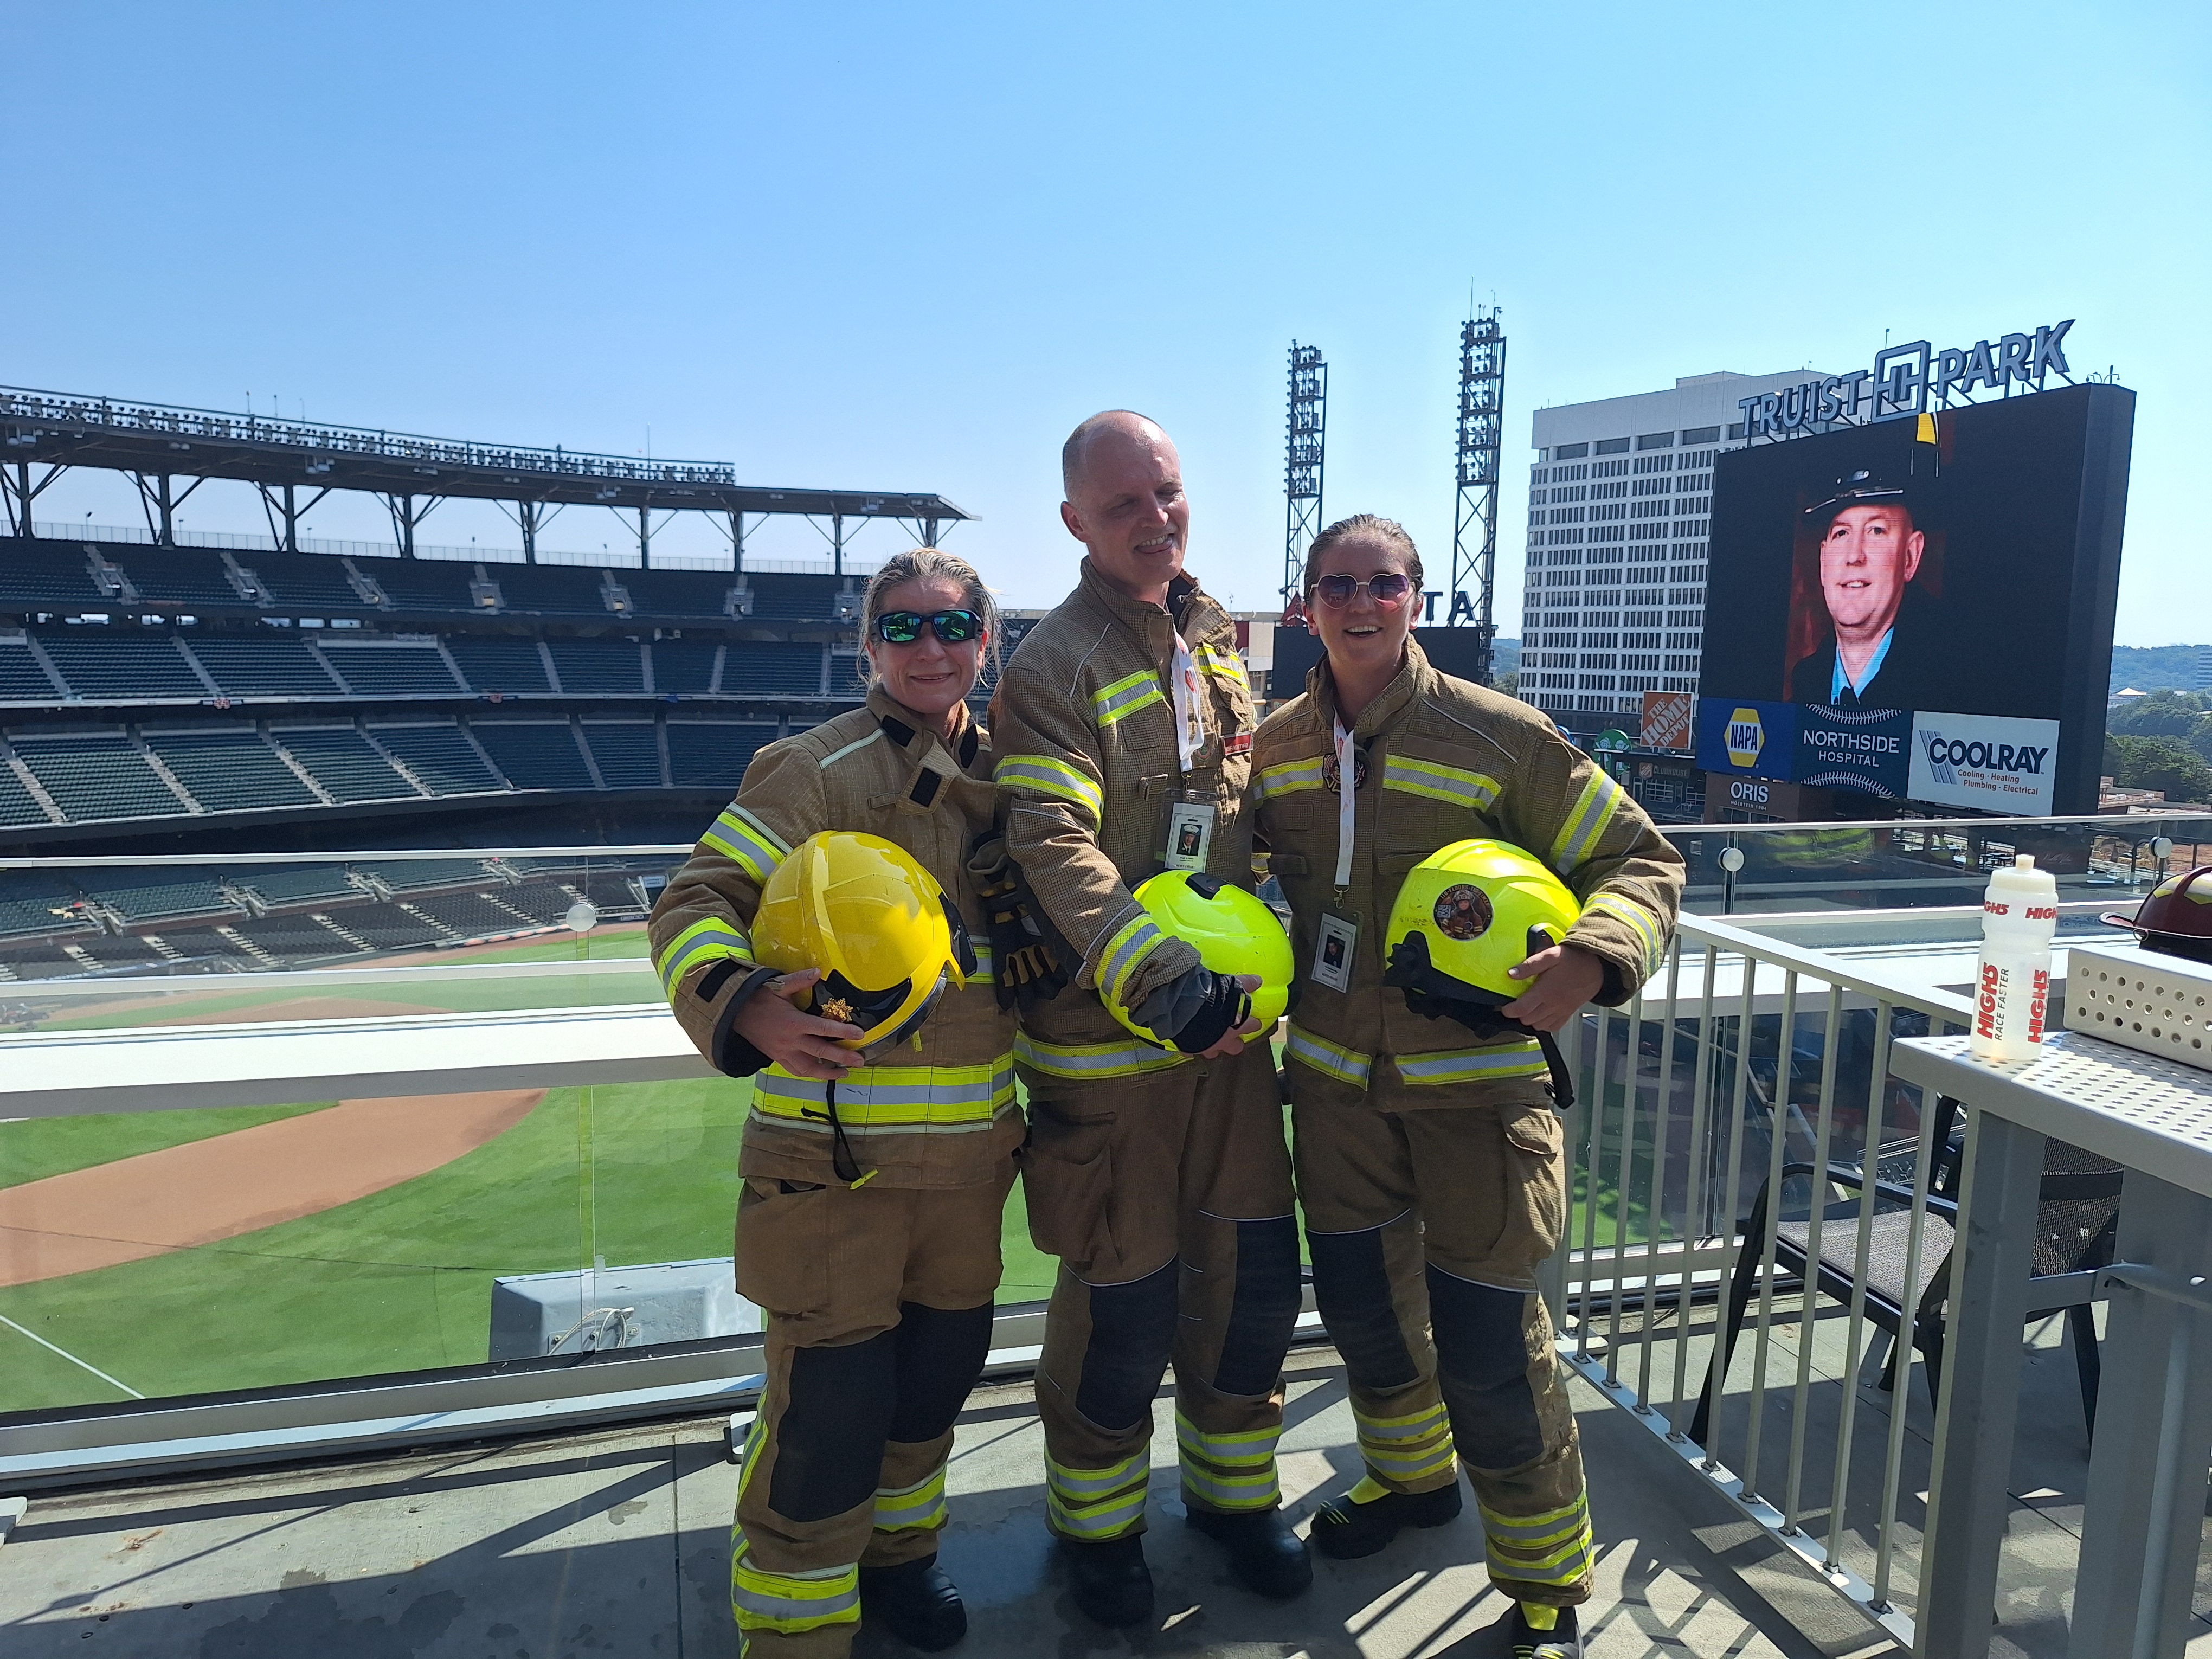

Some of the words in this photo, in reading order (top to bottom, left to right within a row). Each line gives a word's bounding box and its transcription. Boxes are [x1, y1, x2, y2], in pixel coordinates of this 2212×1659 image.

[1738, 370, 1868, 436] TRUIST
[1937, 319, 2076, 398] PARK
[1642, 694, 1691, 747] HOME
[1647, 698, 1668, 719] THE
[1659, 713, 1690, 747] DEPOT
[1730, 724, 1758, 751] NAPA
[1803, 730, 1900, 754] NORTHSIDE
[1819, 750, 1880, 767] HOSPITAL
[1930, 737, 2050, 774] COOLRAY
[1958, 769, 1985, 781] Cooling
[1991, 773, 2020, 784] Heating
[1963, 780, 1997, 792] Plumbing
[2003, 785, 2039, 796] Electrical
[1731, 781, 1769, 803] ORIS
[1985, 901, 2009, 915] GH5
[1977, 962, 1998, 1039] HIGH5
[1997, 968, 2009, 1010] FASTER
[2028, 970, 2048, 1043] HIGH5
[1995, 1013, 2005, 1041] RACE
